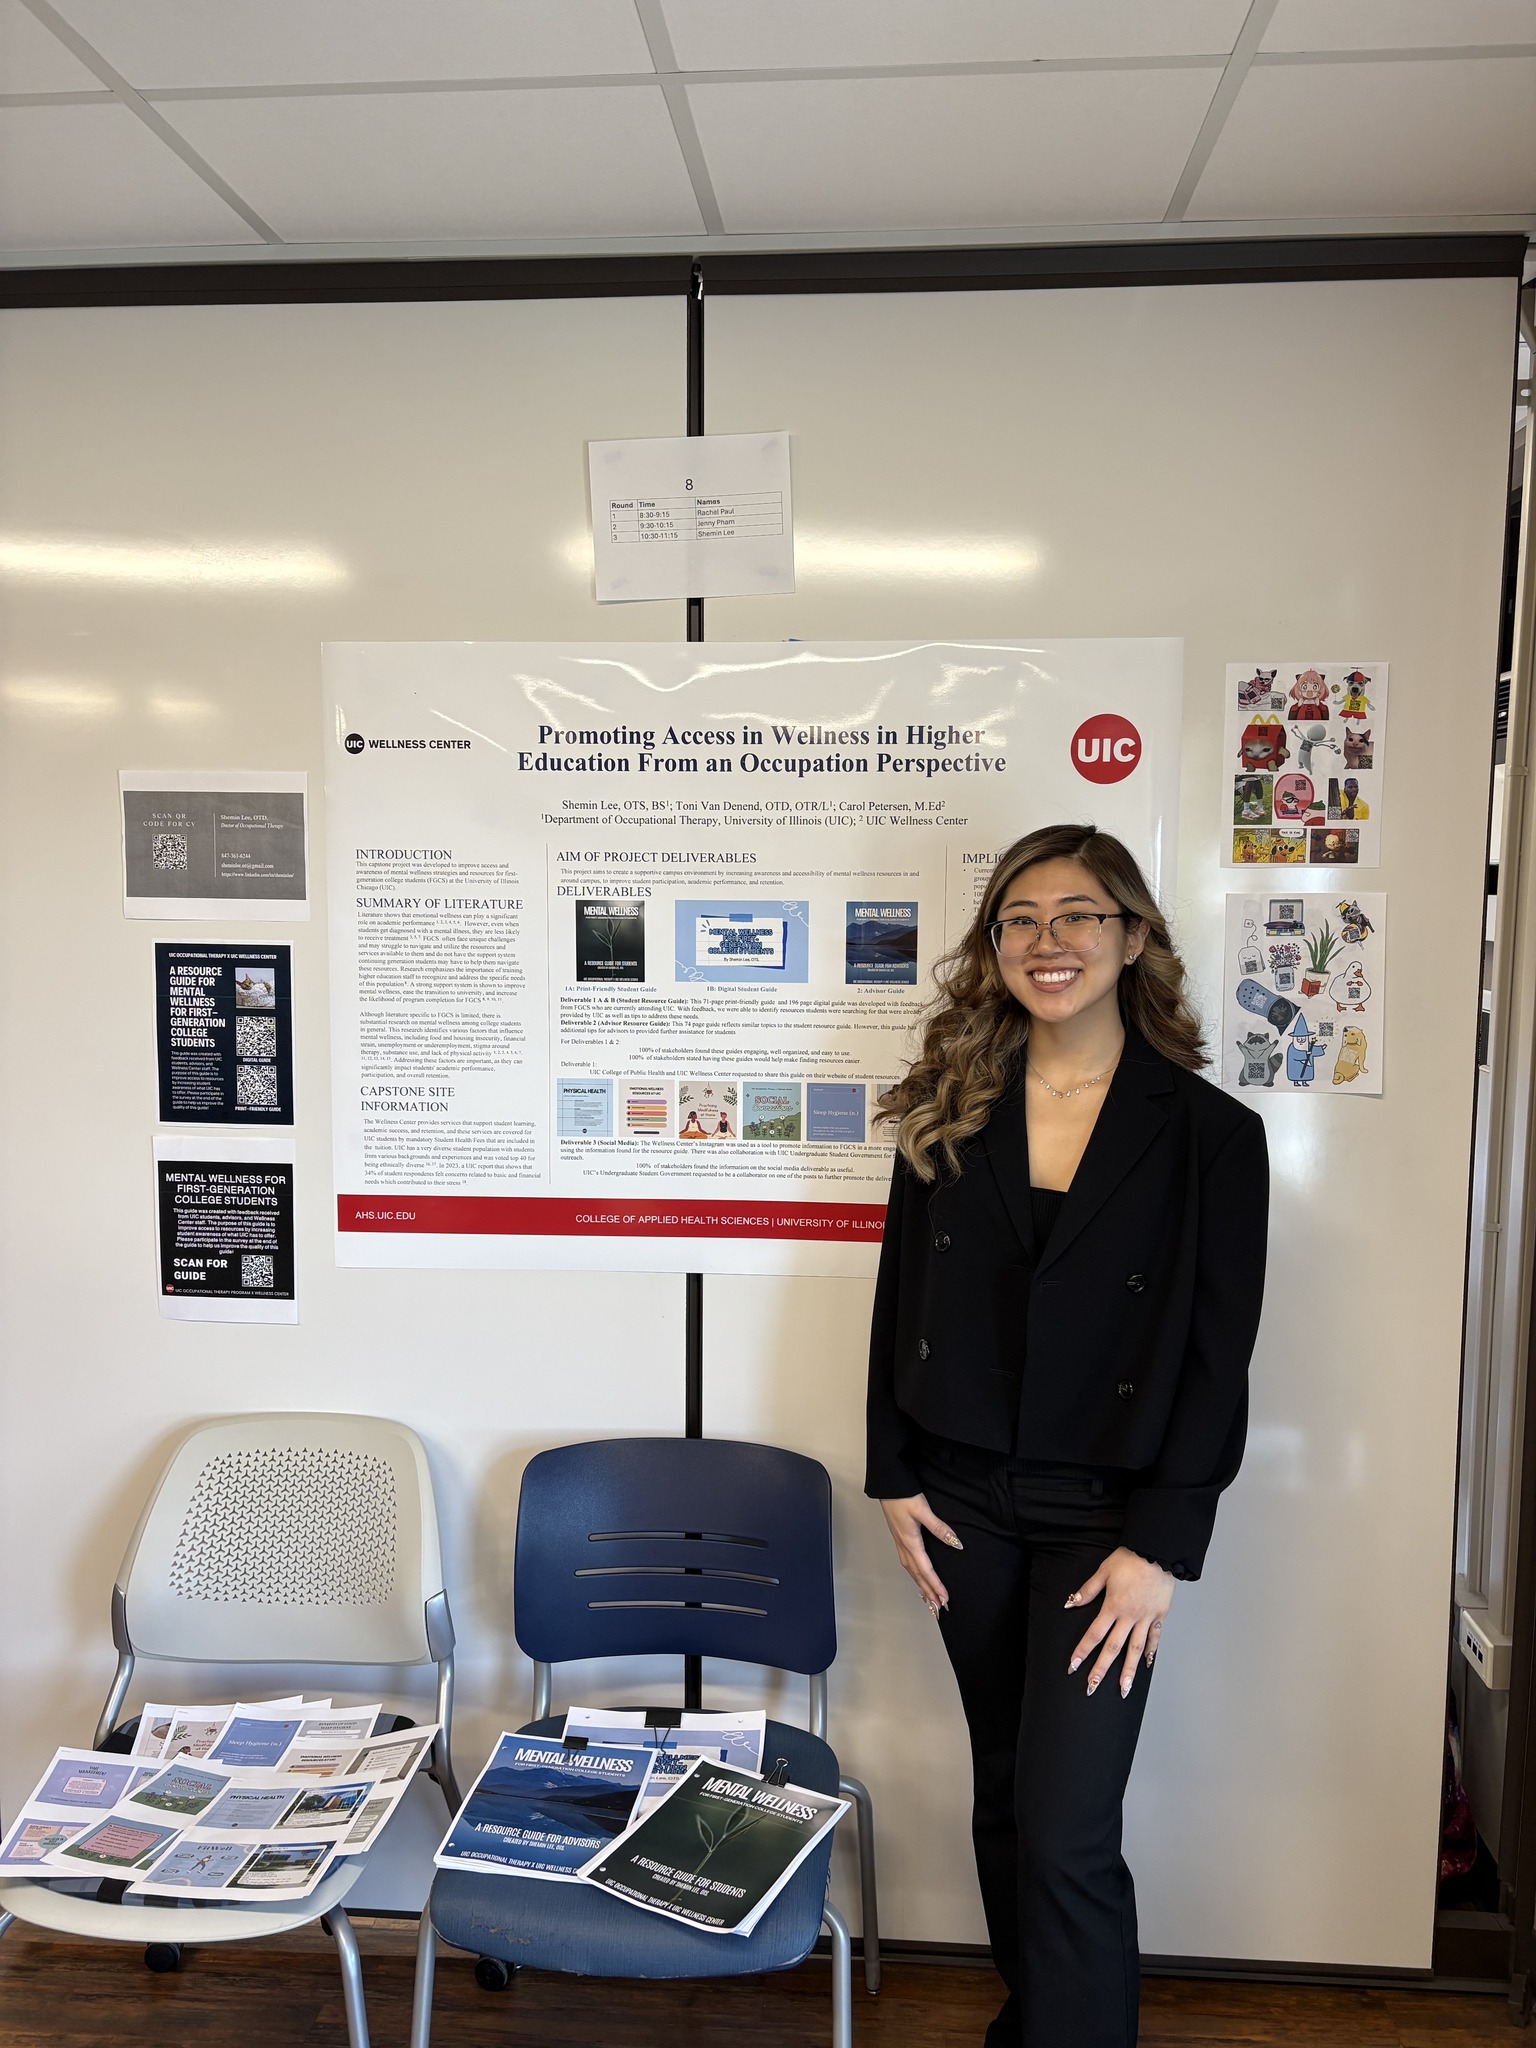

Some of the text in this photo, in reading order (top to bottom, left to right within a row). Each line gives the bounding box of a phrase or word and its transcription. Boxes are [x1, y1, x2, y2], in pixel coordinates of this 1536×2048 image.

[685, 479, 694, 491] 8
[640, 521, 674, 529] 9:30-10:15
[697, 518, 715, 527] Jenny
[698, 529, 722, 537] Shemin
[537, 725, 986, 750] Promoting Access in Wellness in Higher
[368, 739, 427, 749] WELLNESS
[429, 739, 471, 750] CENTER
[1077, 737, 1136, 763] UIC
[517, 752, 1006, 777] Education From an Occupation Perspective
[562, 800, 598, 810] Shemin
[600, 801, 621, 811] Lee,
[623, 801, 649, 812] OTS,
[676, 801, 698, 811] Toni
[701, 802, 720, 811] Van
[723, 801, 762, 812] Denend,
[765, 802, 792, 812] OTD,
[839, 801, 866, 811] Carol
[869, 802, 911, 812] Petersen,
[602, 814, 612, 824] of
[614, 815, 677, 827] Occupational
[679, 816, 721, 827] Therapy,
[724, 816, 772, 827] University
[776, 816, 787, 826] of
[789, 816, 822, 826] Illinois
[824, 816, 857, 827] (UIC);
[866, 817, 886, 826] UIC
[890, 816, 933, 826] Wellness
[936, 817, 968, 826] Center
[356, 849, 452, 860] INTRODUCTION
[557, 852, 757, 863] AIM OF PROJECT DELIVERABLES
[557, 886, 652, 897] DELIVERABLES
[356, 898, 524, 910] SUMMARY OF LITERATURE
[170, 967, 222, 976] A RESOURCE
[170, 977, 215, 987] GUIDE FOR
[170, 987, 205, 996] MENTAL
[170, 997, 215, 1007] WELLNESS
[171, 1008, 218, 1017] FOR FIRST-
[171, 1018, 226, 1027] GENERATION
[171, 1028, 208, 1037] COLLEGE
[171, 1038, 215, 1048] STUDENTS
[360, 1086, 455, 1097] CAPSTONE SITE
[361, 1101, 449, 1112] INFORMATION
[166, 1174, 286, 1185] MENTAL WELLNESS FOR
[177, 1185, 275, 1195] FIRST-GENERATION
[174, 1195, 278, 1206] COLLEGE STUDENTS
[355, 1211, 885, 1229] AHS.UIC.EDU COLLEGE OF APPLIED HEALTH SCIENCES UNIVERSITY OF ILLINOI
[174, 1259, 228, 1268] SCAN FOR
[174, 1272, 206, 1281] GUIDE
[514, 1748, 634, 1772] MENTAL WELLNESS
[701, 1777, 818, 1821] MENTAL WELLNESS
[475, 1823, 601, 1849] A RESOURCE GUIDE FOR ADVISORS
[631, 1855, 747, 1898] A RESOURCE GUIDE FOR STUDENTS
[614, 1881, 649, 1902] OCCUPATIONAL
[647, 1894, 670, 1907] THERAPY
[672, 1902, 683, 1911] UIC
[681, 1906, 707, 1919] WELLNESS
[705, 1914, 725, 1925] CENTER
